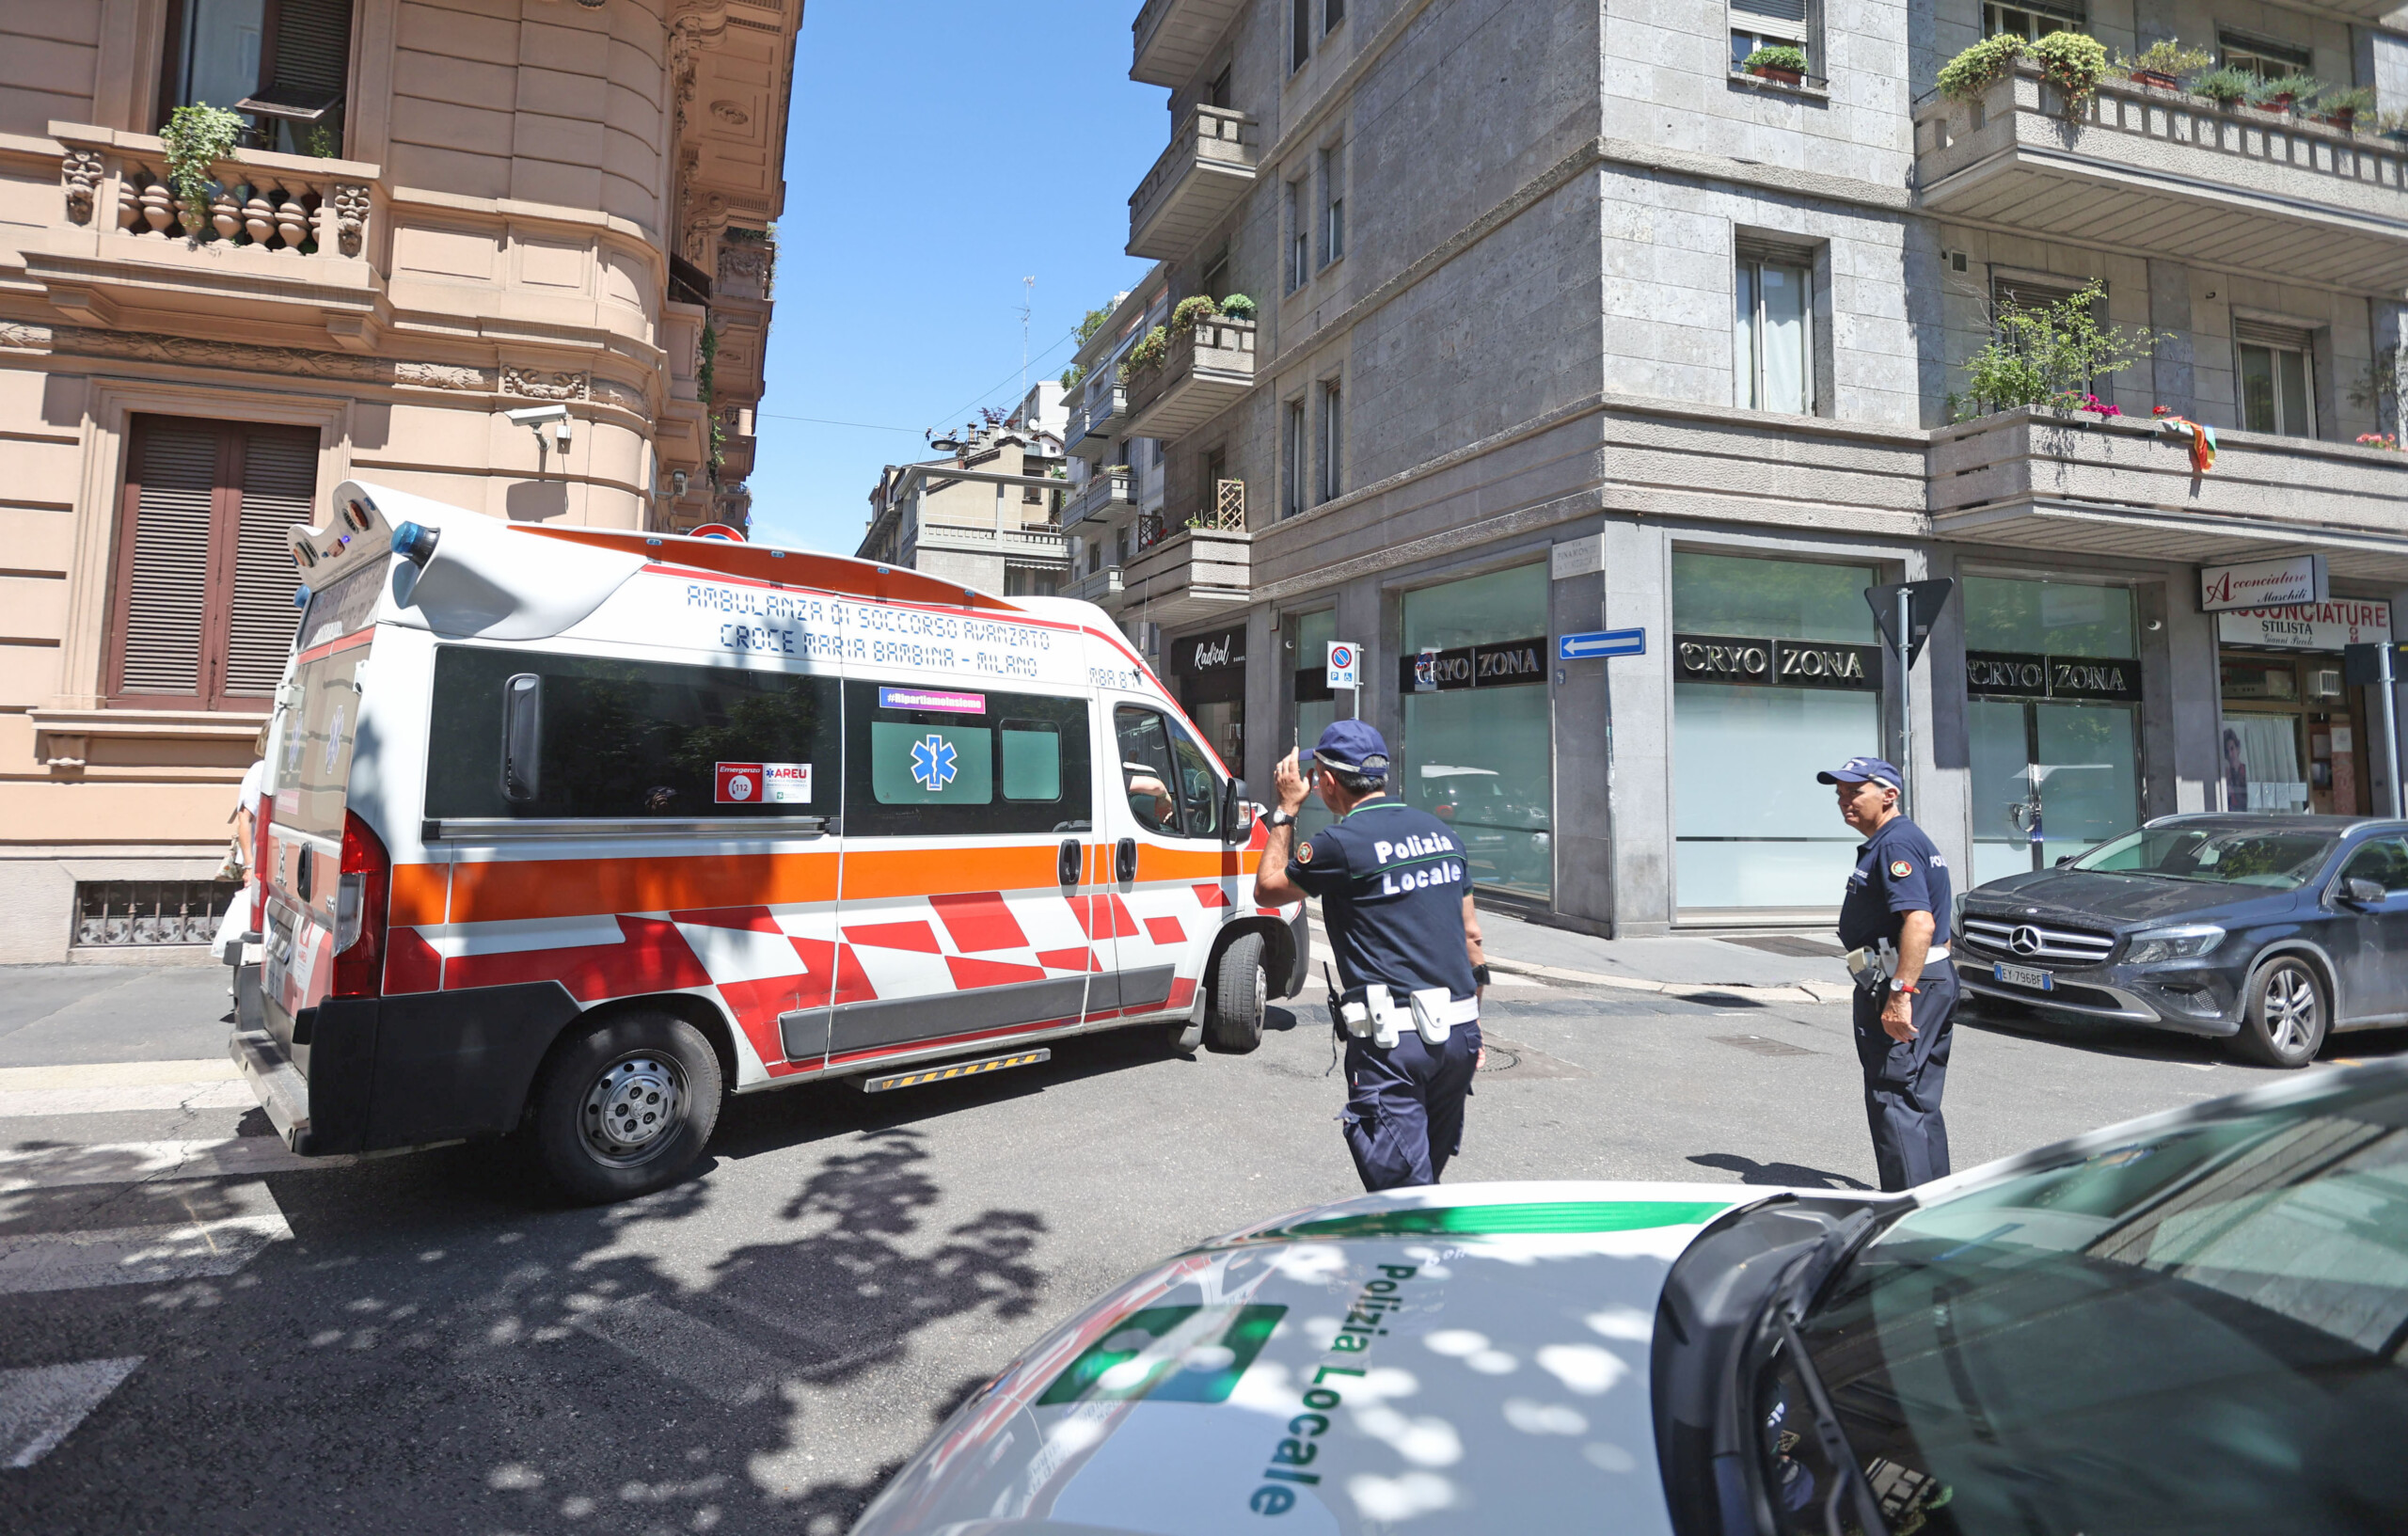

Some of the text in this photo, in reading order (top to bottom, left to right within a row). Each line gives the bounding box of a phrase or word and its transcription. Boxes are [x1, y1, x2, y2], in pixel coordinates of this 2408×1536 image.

[2258, 589, 2307, 603] Maschili
[688, 585, 1050, 650] AMBULANZA DI SOCCORSO AVANZATO
[2261, 621, 2313, 635] STILISTA
[721, 624, 795, 654] CROCE
[804, 633, 865, 659] MARIA
[874, 641, 955, 668] BAMBINA
[977, 652, 1038, 677] MILANO
[1195, 634, 1229, 671] Radical
[1416, 648, 1540, 683] CRYO ZONA
[1679, 641, 1865, 678] CRYO ZONA
[1089, 667, 1116, 687] MBA
[1967, 659, 2128, 691] CRYO ZONA
[736, 784, 748, 792] 112
[774, 768, 807, 779] AREU
[1373, 831, 1454, 864] Polizia
[1383, 861, 1462, 895] Locale
[2003, 968, 2042, 986] EY 796BF
[1249, 1263, 1418, 1517] Polizia Locale
